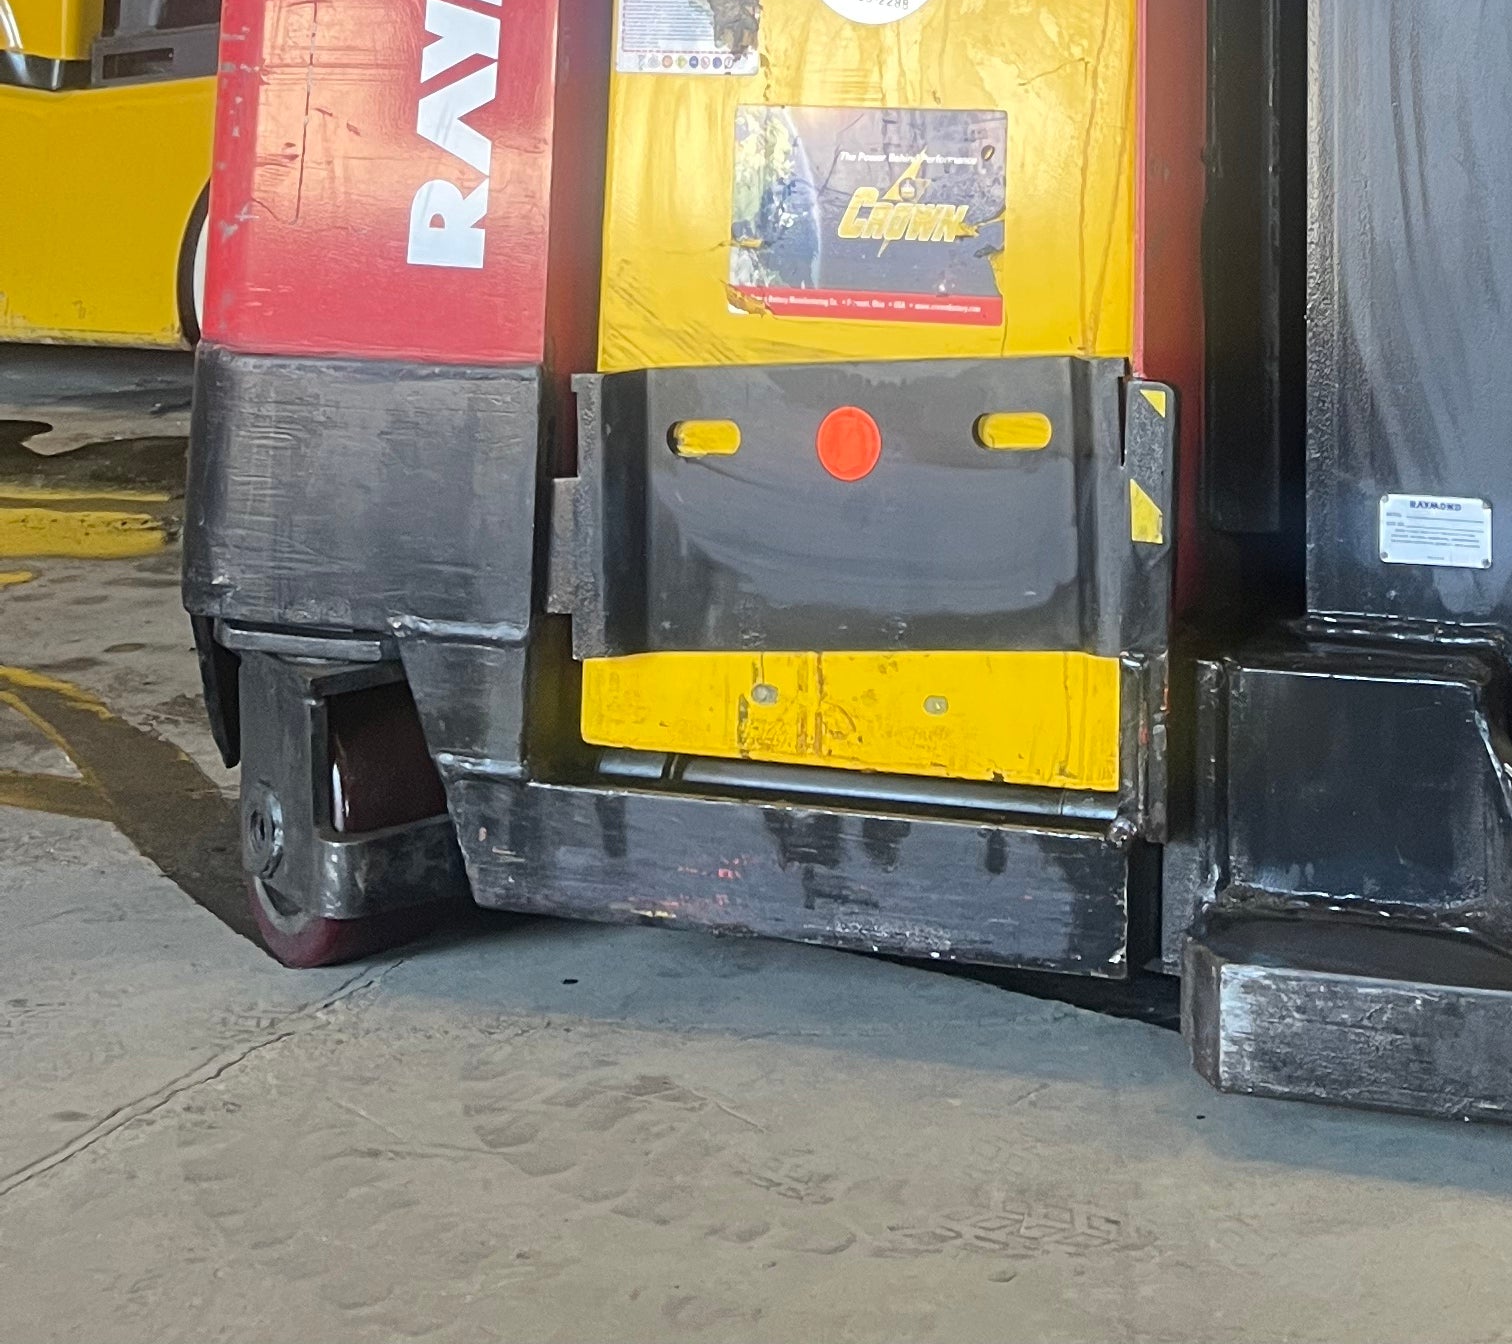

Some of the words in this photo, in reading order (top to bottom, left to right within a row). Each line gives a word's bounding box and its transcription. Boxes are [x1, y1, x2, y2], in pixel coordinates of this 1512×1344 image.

[840, 151, 857, 161] The
[858, 151, 888, 162] Power
[837, 186, 969, 242] CROWN
[1409, 499, 1463, 511] RAYMOND
